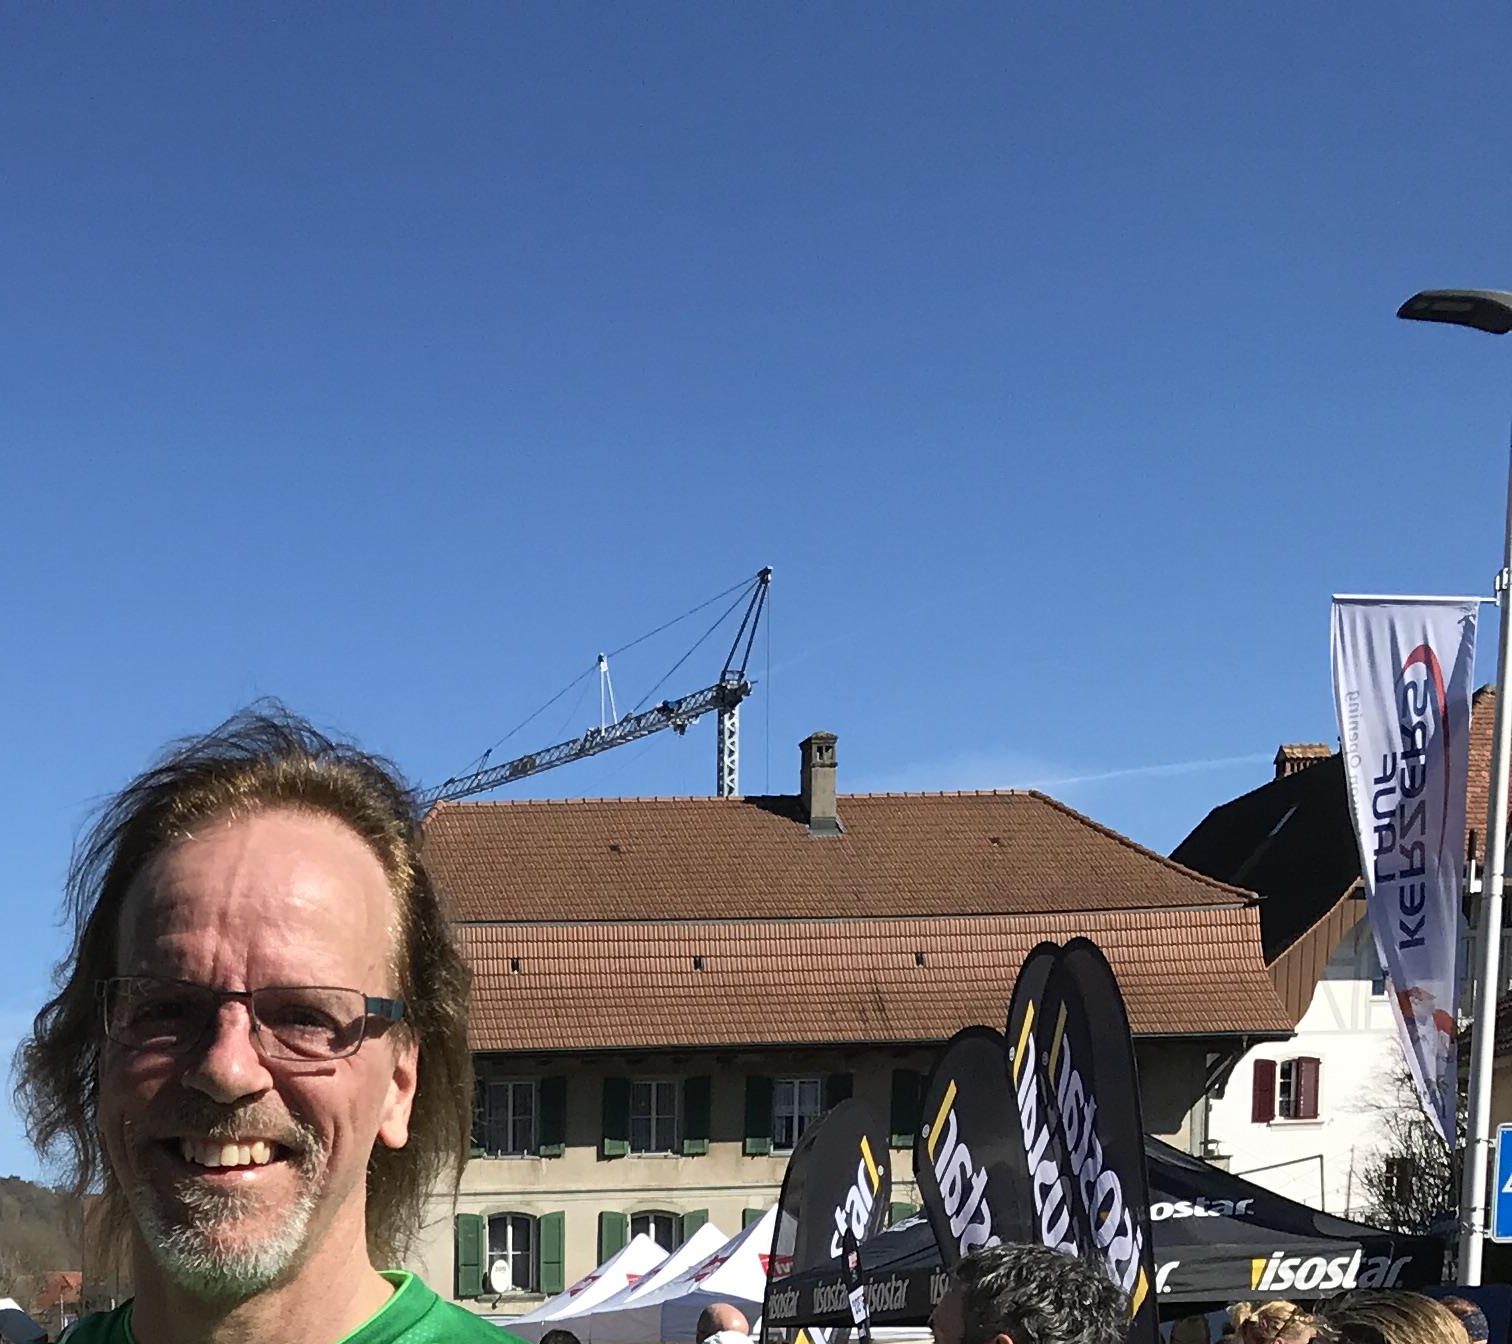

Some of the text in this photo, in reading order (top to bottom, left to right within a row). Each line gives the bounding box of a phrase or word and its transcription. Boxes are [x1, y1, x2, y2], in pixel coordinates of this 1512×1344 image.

[1150, 1197, 1255, 1221] ostar
[1258, 1249, 1412, 1291] isostar
[817, 1277, 848, 1314] isosta
